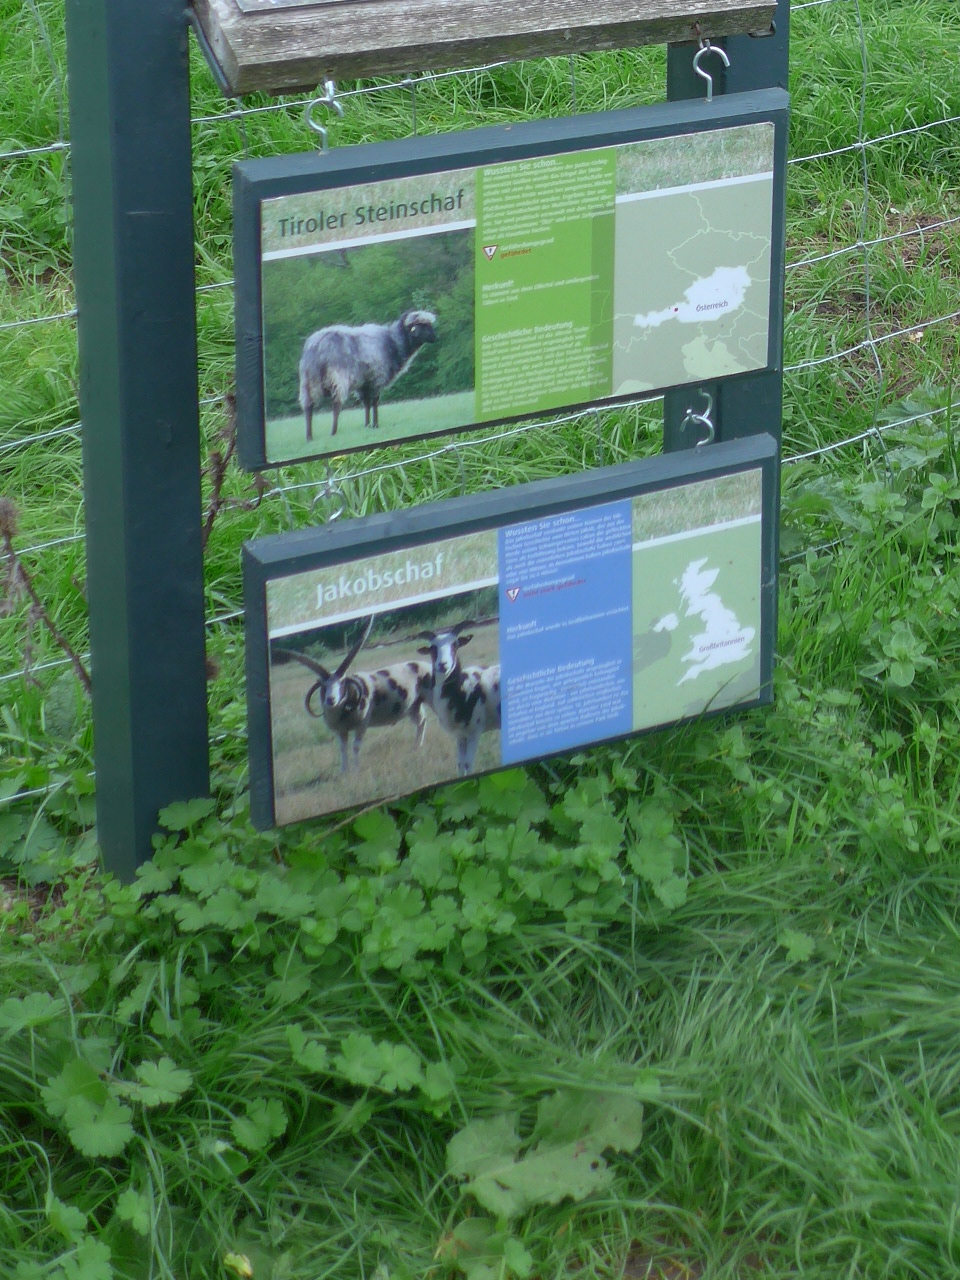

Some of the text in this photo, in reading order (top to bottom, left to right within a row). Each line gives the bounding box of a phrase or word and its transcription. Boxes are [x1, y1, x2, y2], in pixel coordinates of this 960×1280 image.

[483, 165, 517, 177] Wussten
[519, 162, 531, 171] Sie
[278, 188, 465, 237] Tiroler Steinschaf
[695, 299, 729, 312] Österreich
[505, 524, 537, 538] Wussten
[539, 521, 551, 530] Sie
[316, 554, 443, 608] Jakobschaf
[698, 634, 746, 654] Großbritannien
